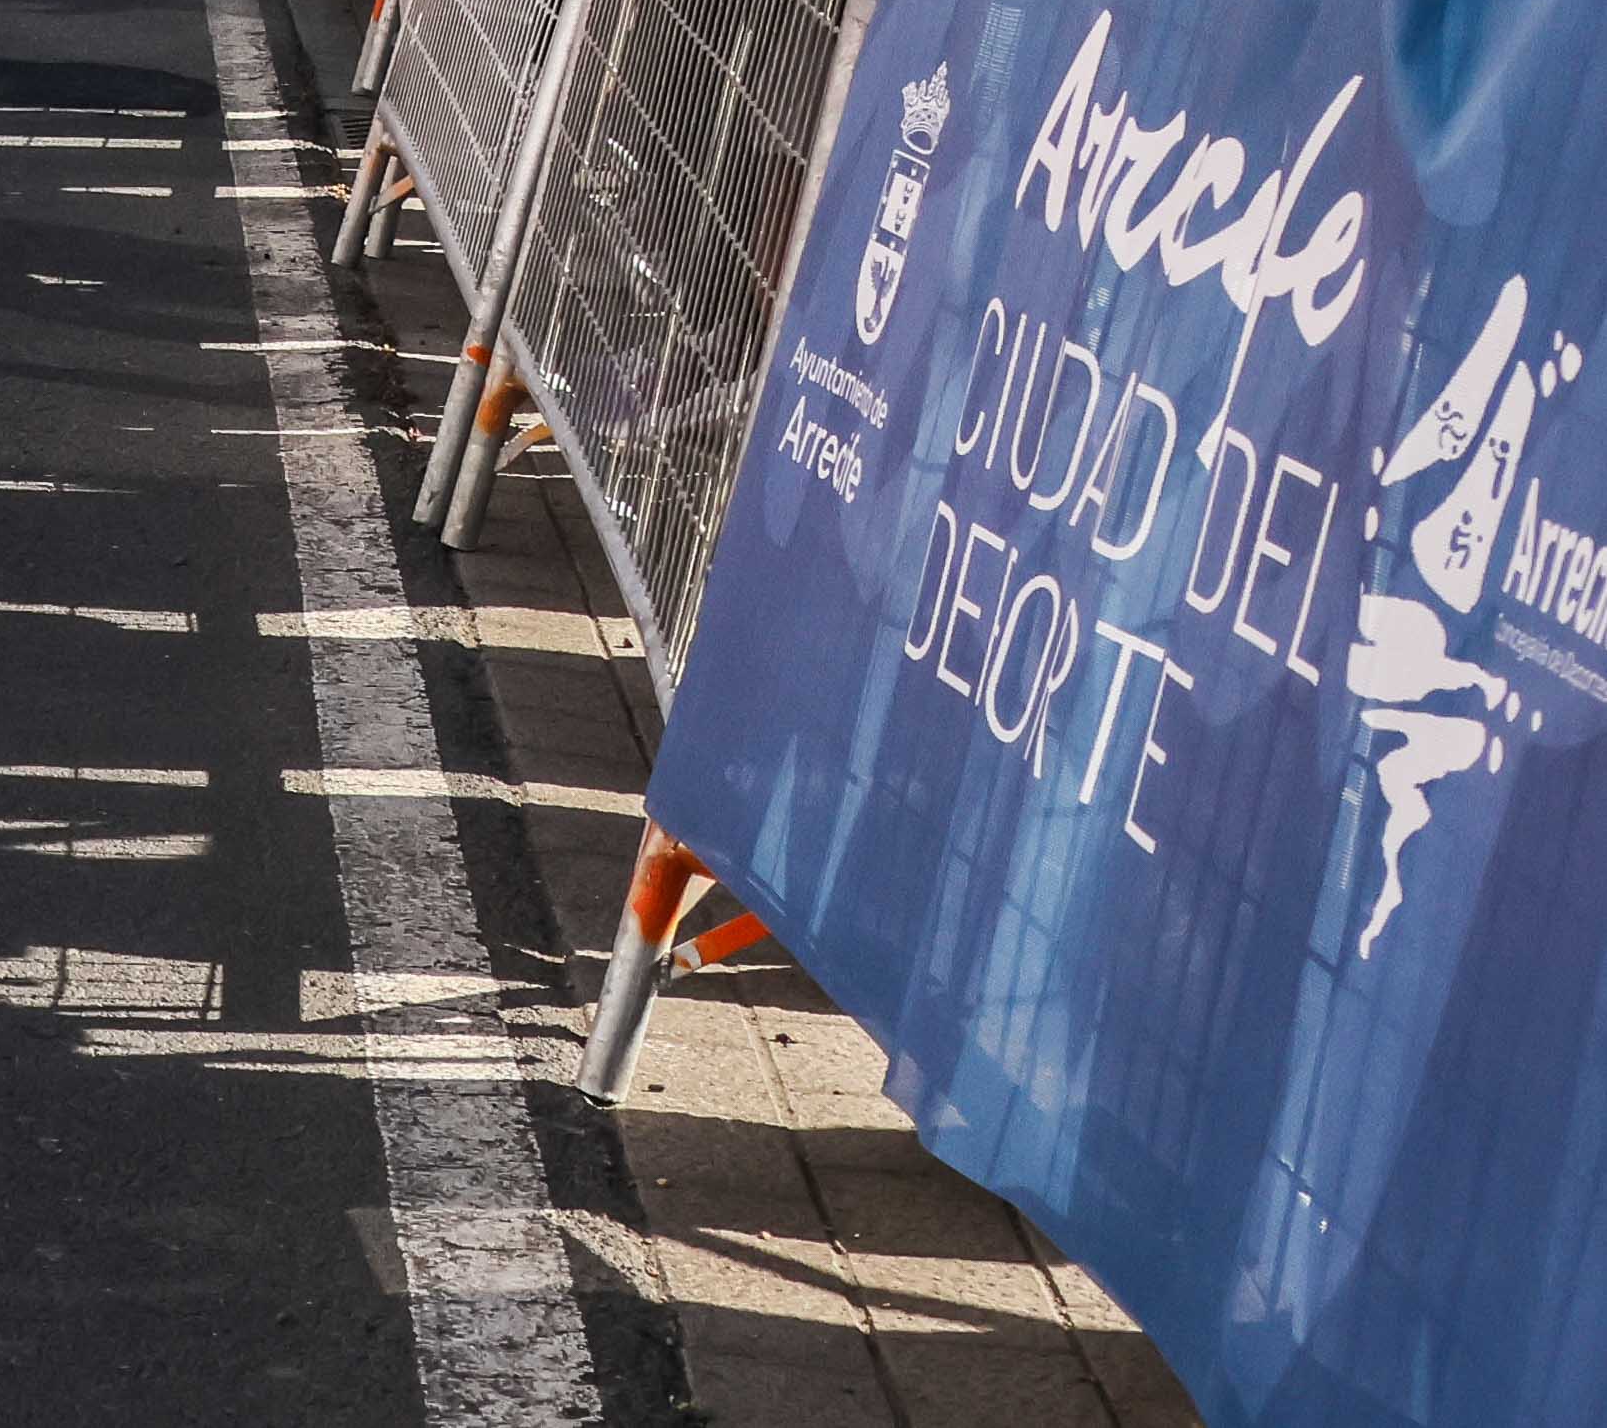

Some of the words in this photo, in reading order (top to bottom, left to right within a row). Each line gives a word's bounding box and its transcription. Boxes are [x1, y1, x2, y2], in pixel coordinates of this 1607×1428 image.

[870, 388, 888, 430] de
[954, 296, 1178, 562] CIUDAD
[1185, 426, 1339, 687] DEL
